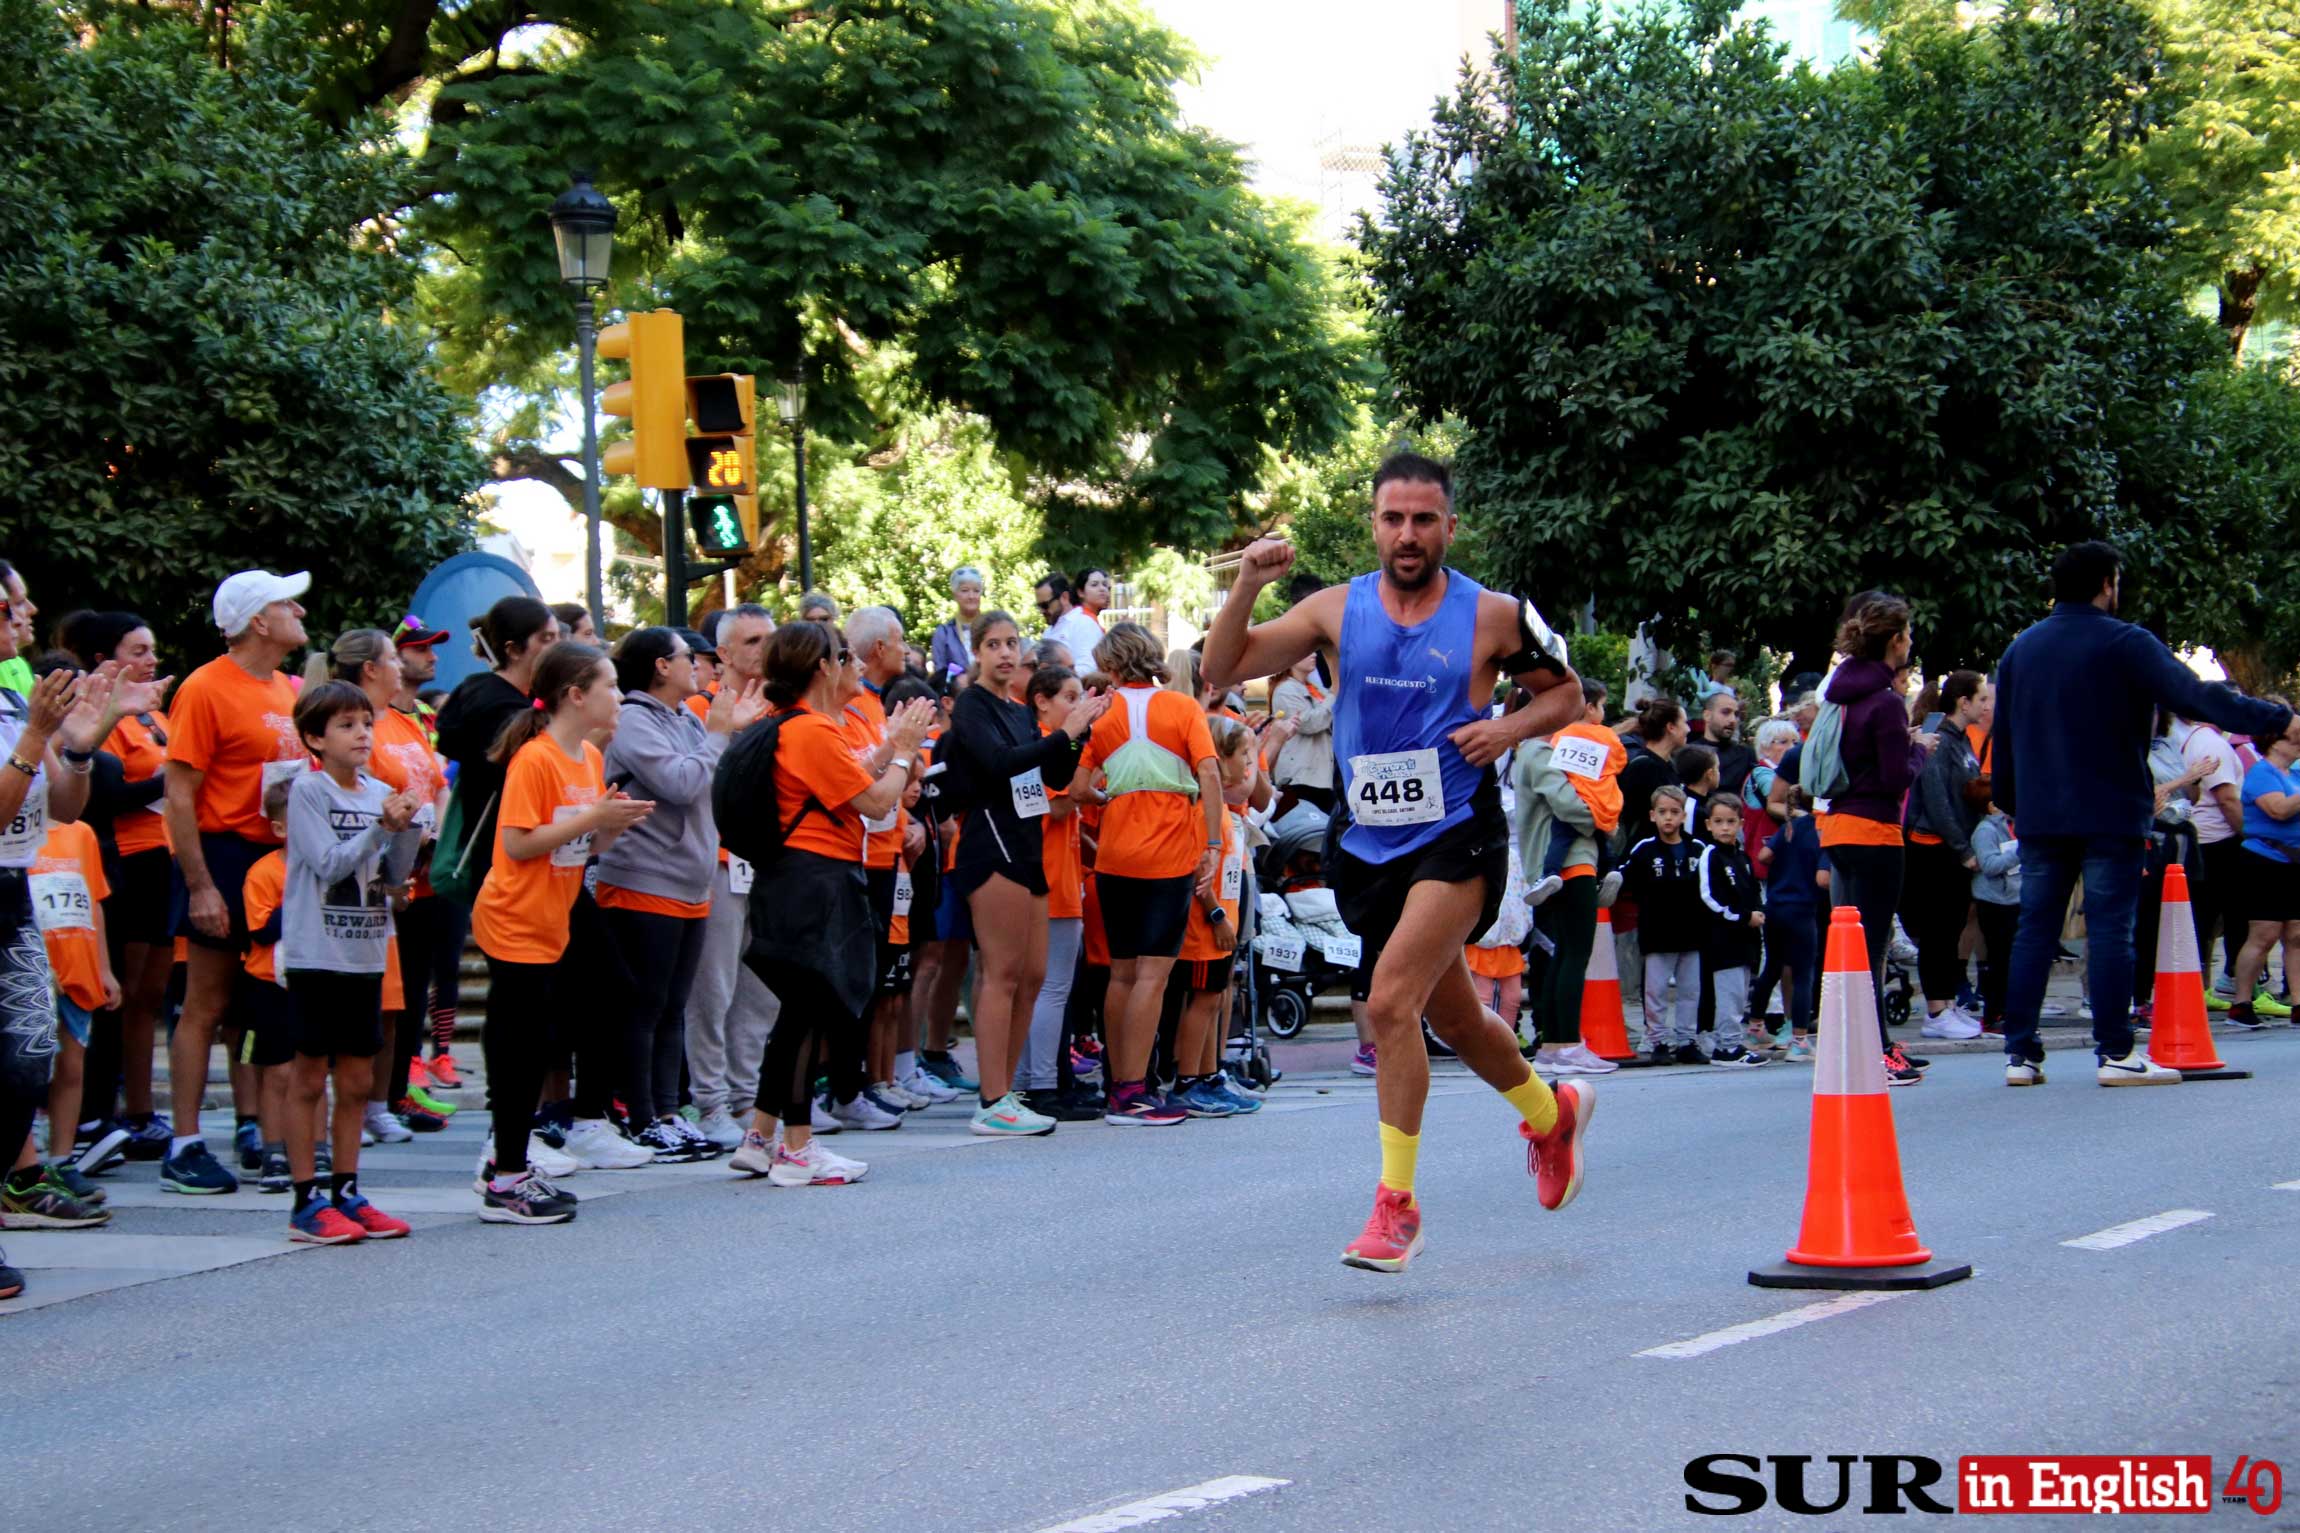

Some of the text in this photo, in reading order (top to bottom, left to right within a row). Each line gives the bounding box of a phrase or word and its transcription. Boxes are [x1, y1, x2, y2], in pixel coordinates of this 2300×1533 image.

[707, 450, 741, 486] 20
[1365, 676, 1426, 689] RETROGUSTO
[1560, 748, 1599, 767] 1753
[1015, 783, 1043, 801] 1948
[1360, 778, 1424, 805] 448
[42, 893, 89, 910] 1725
[323, 914, 388, 927] REWARD
[1269, 946, 1298, 961] 1937
[1328, 946, 1359, 958] 1938
